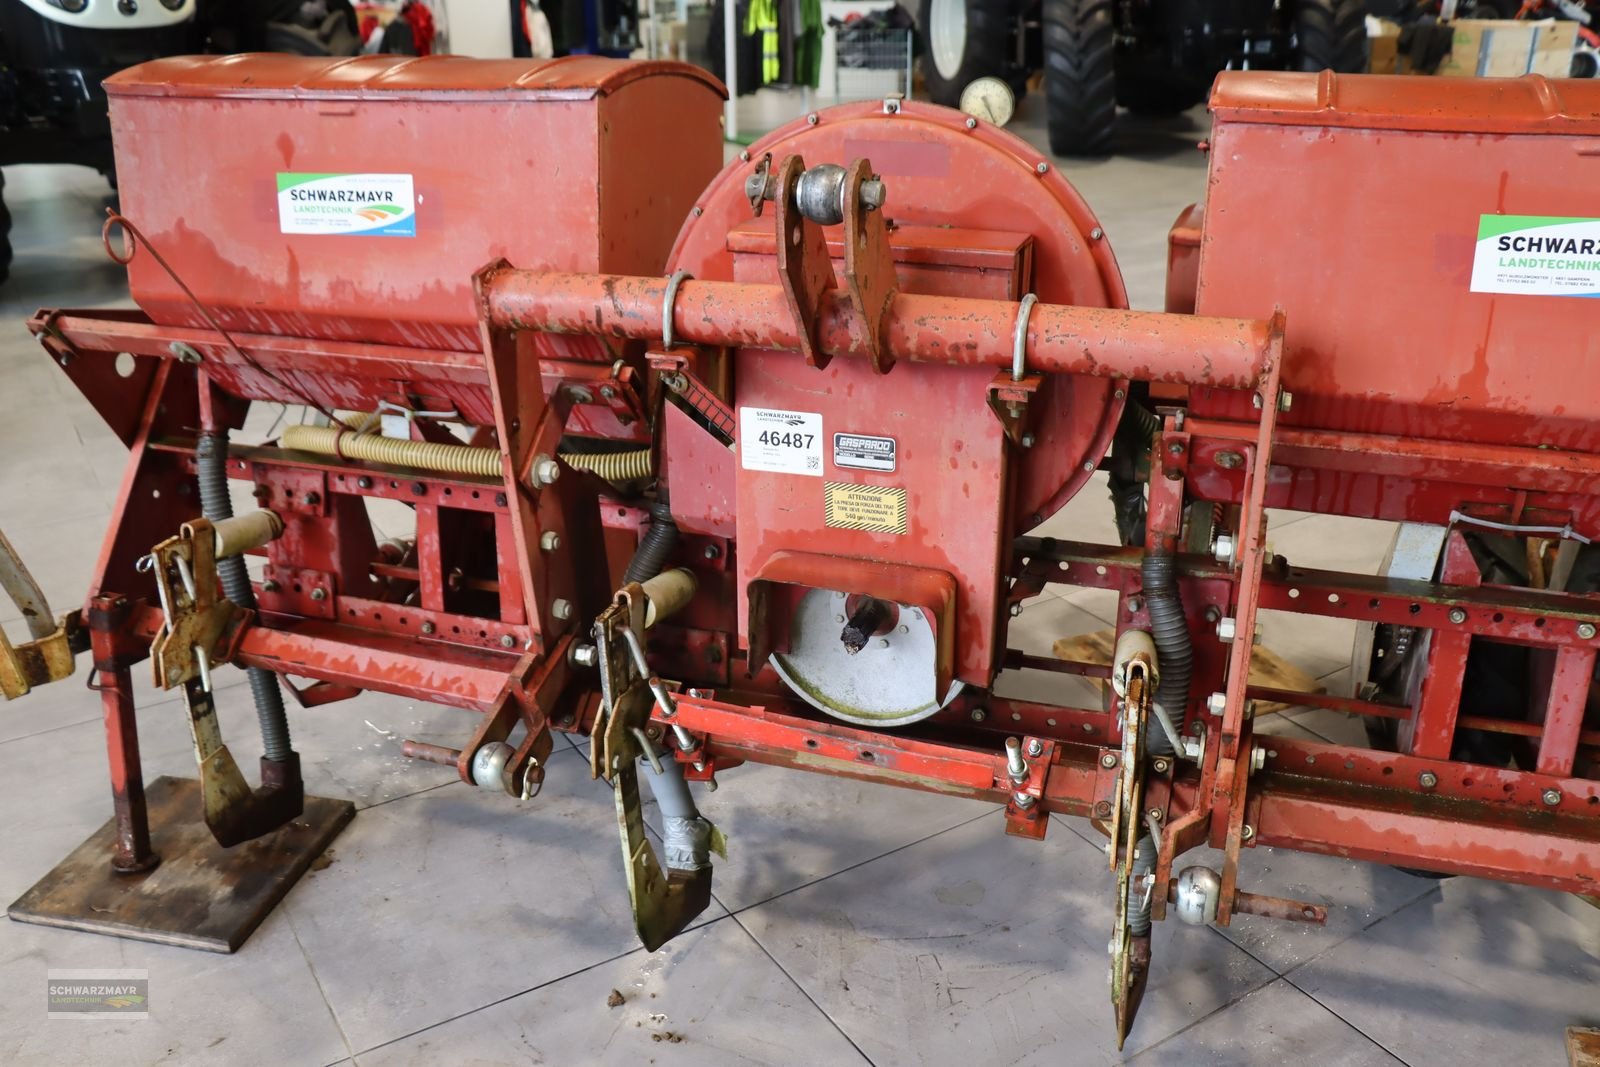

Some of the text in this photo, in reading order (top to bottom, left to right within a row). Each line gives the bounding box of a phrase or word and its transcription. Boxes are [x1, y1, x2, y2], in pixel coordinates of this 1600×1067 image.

[290, 189, 393, 202] SCHWARZMAYR
[294, 204, 352, 214] LANDTECHNIK
[756, 411, 802, 420] SCHWARZMAYR
[758, 430, 814, 449] 46487
[839, 437, 890, 450] GASPARDO
[848, 494, 882, 502] ATTENZIONE
